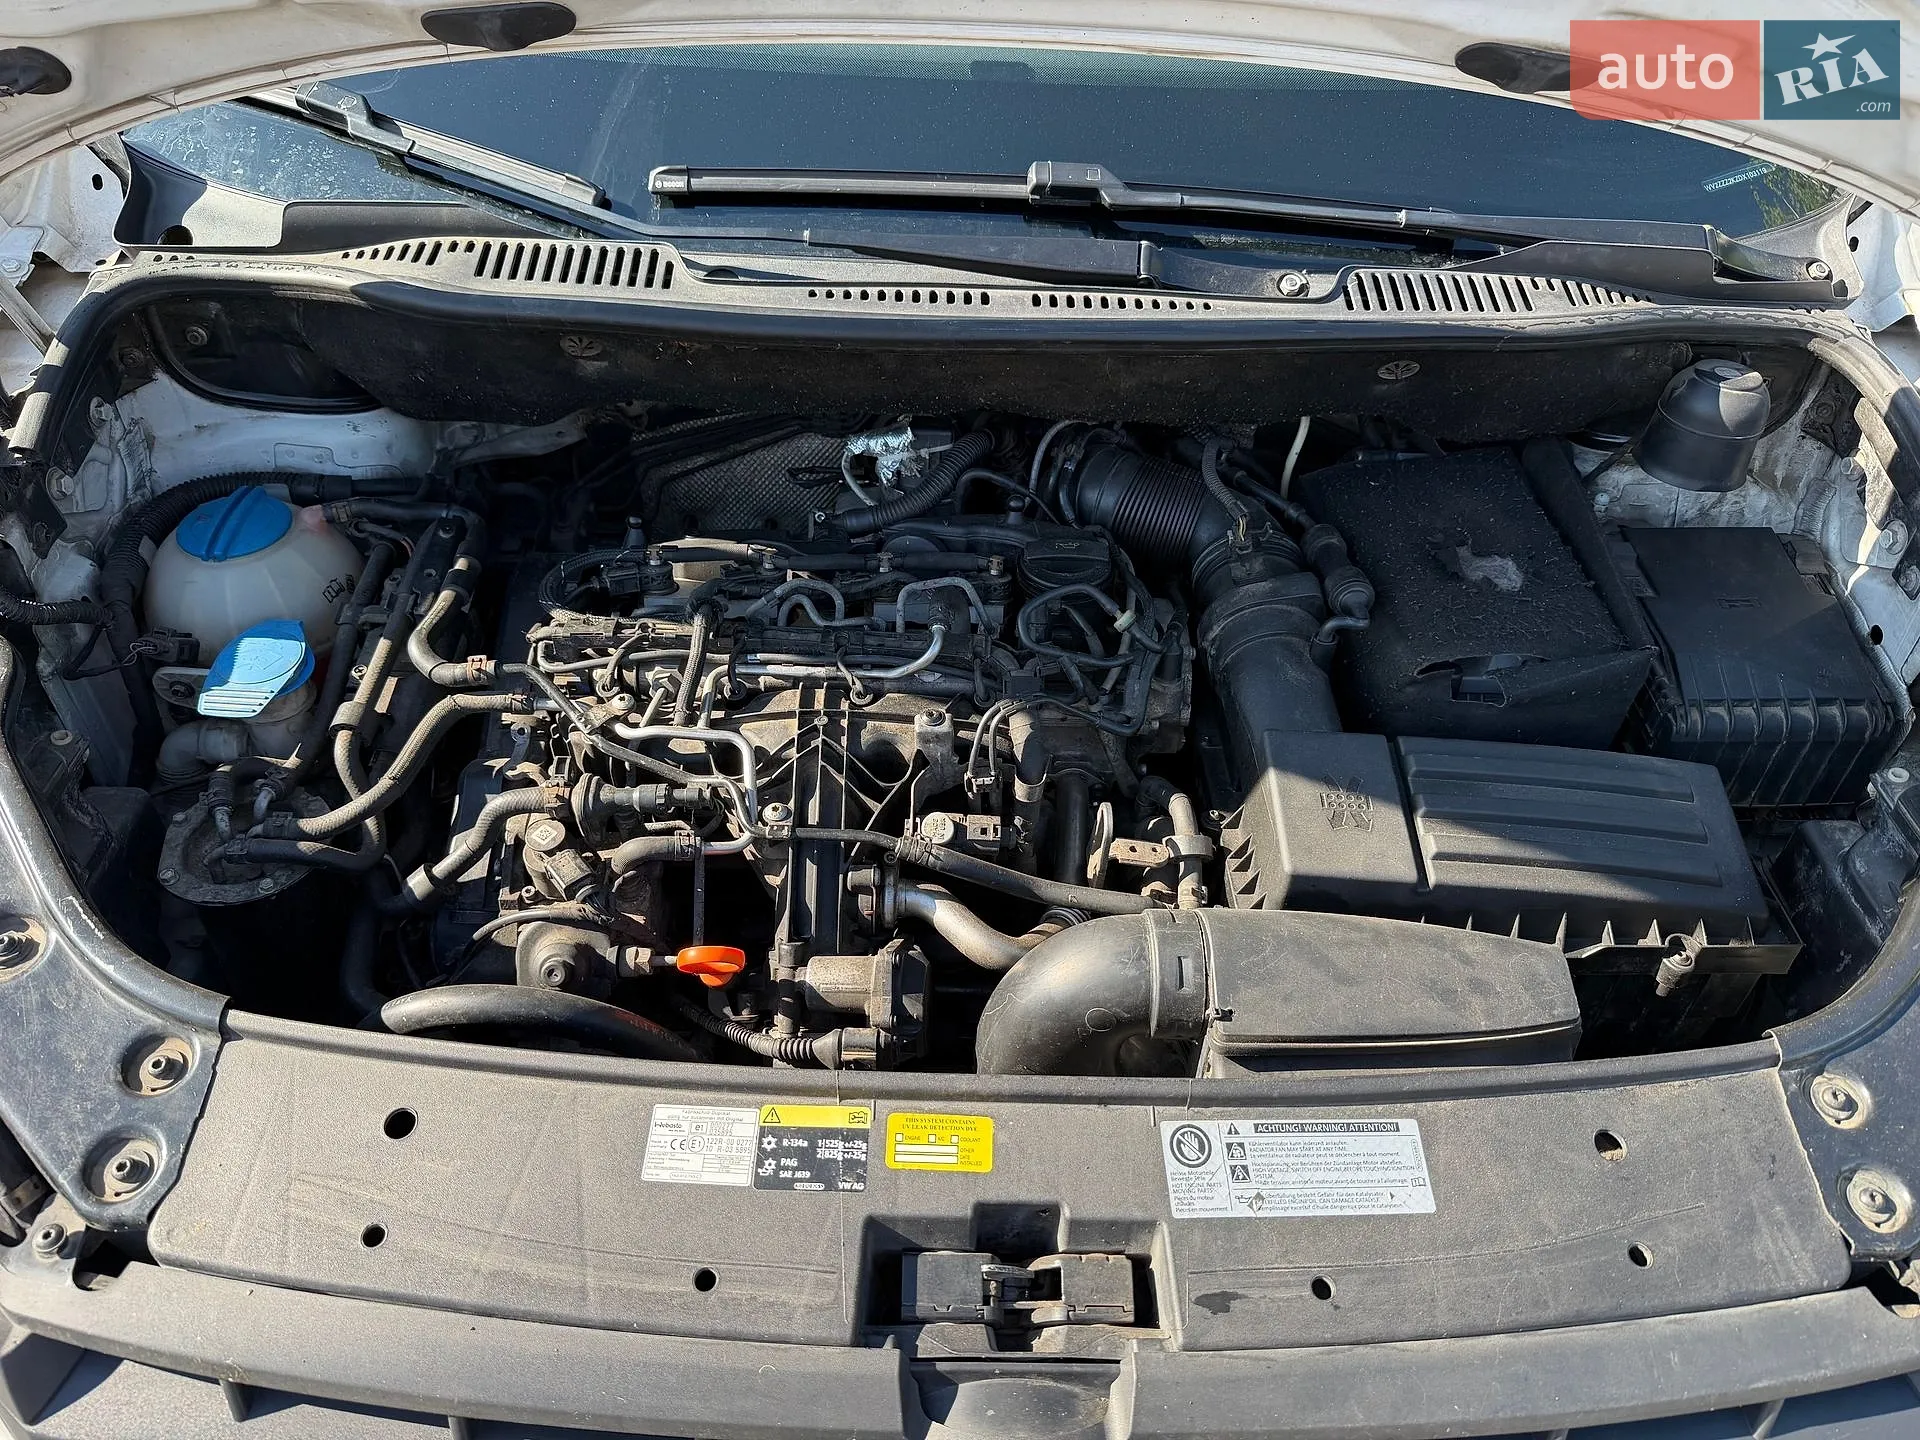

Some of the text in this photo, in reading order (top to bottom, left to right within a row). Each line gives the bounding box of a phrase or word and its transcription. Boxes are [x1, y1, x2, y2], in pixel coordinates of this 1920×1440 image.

[654, 1121, 683, 1129] Webasto
[694, 1124, 704, 1132] e1
[1257, 1123, 1398, 1132] ACHTUNG! WARNING! ATTENTION!
[783, 1139, 808, 1147] R-134a
[780, 1158, 798, 1167] PAG
[779, 1170, 811, 1179] SAE J639
[838, 1182, 865, 1190] VW AG
